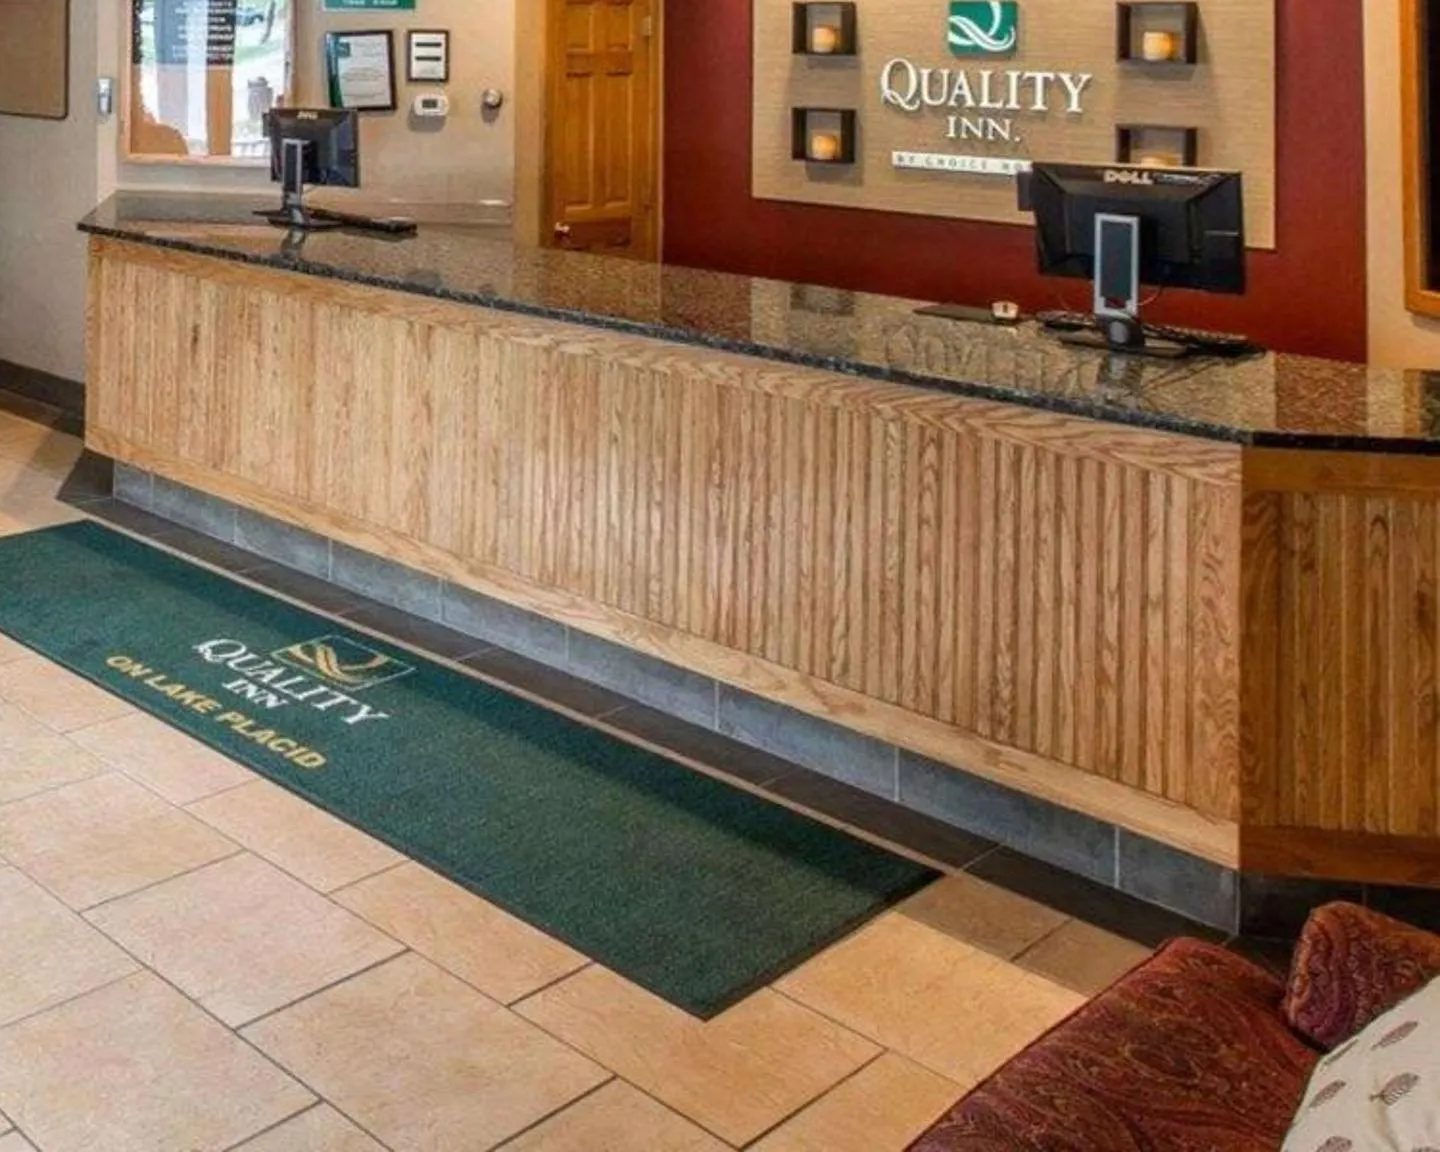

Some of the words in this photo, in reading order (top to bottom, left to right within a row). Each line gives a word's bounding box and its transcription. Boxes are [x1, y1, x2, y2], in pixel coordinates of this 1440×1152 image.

[880, 57, 1093, 113] QUALITY
[924, 156, 988, 170] CHOICE
[1102, 170, 1154, 186] DELL
[193, 638, 391, 726] QUALITY
[221, 678, 290, 710] INN
[106, 655, 145, 679] ON
[144, 671, 222, 715] LAKE
[215, 710, 328, 770] PLACID
